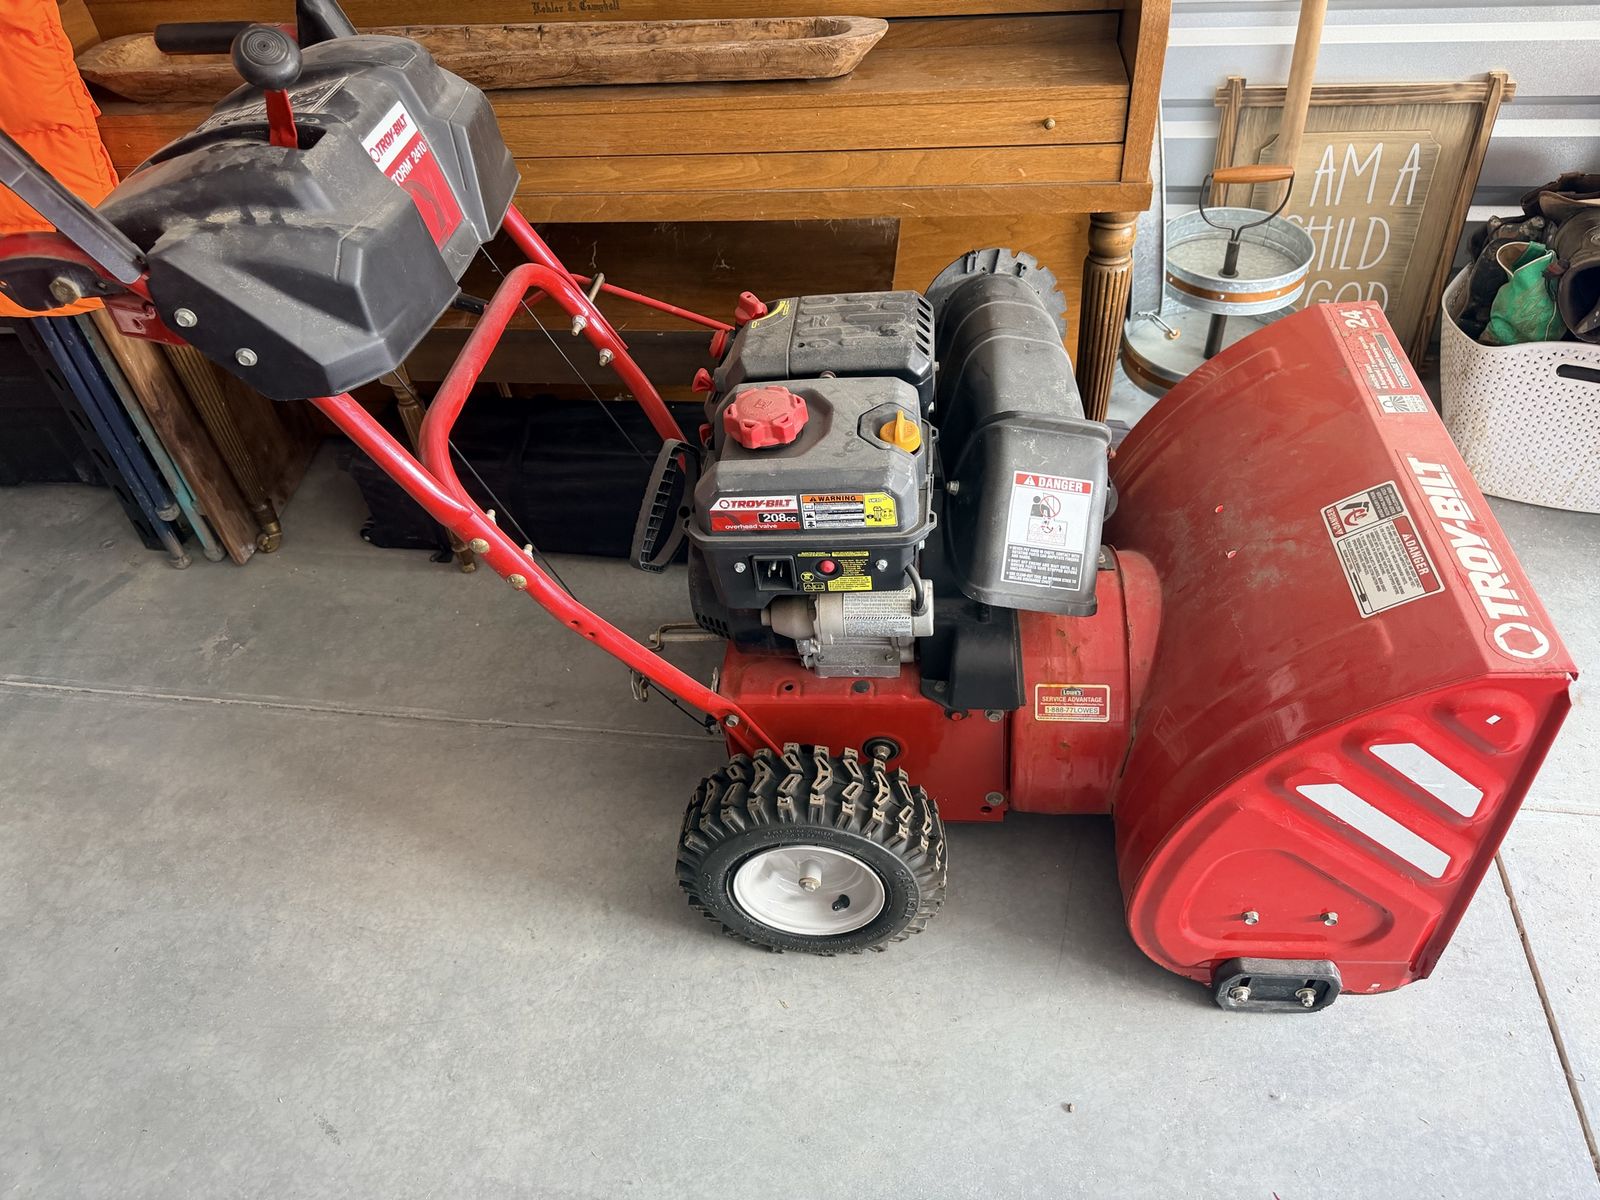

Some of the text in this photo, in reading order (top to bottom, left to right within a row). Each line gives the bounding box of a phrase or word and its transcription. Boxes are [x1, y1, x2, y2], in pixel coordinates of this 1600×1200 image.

[567, 1, 576, 11] &
[375, 113, 407, 157] TROY-BILT
[410, 140, 427, 165] 2410
[1309, 142, 1421, 208] AM A
[1286, 214, 1391, 272] HILD
[1038, 477, 1083, 493] DANGER
[730, 499, 792, 509] TROY-BILT
[818, 494, 856, 502] WARNING
[762, 513, 797, 523] 208cc
[1407, 456, 1529, 620] TROY-BILT
[1405, 538, 1430, 576] DANGER
